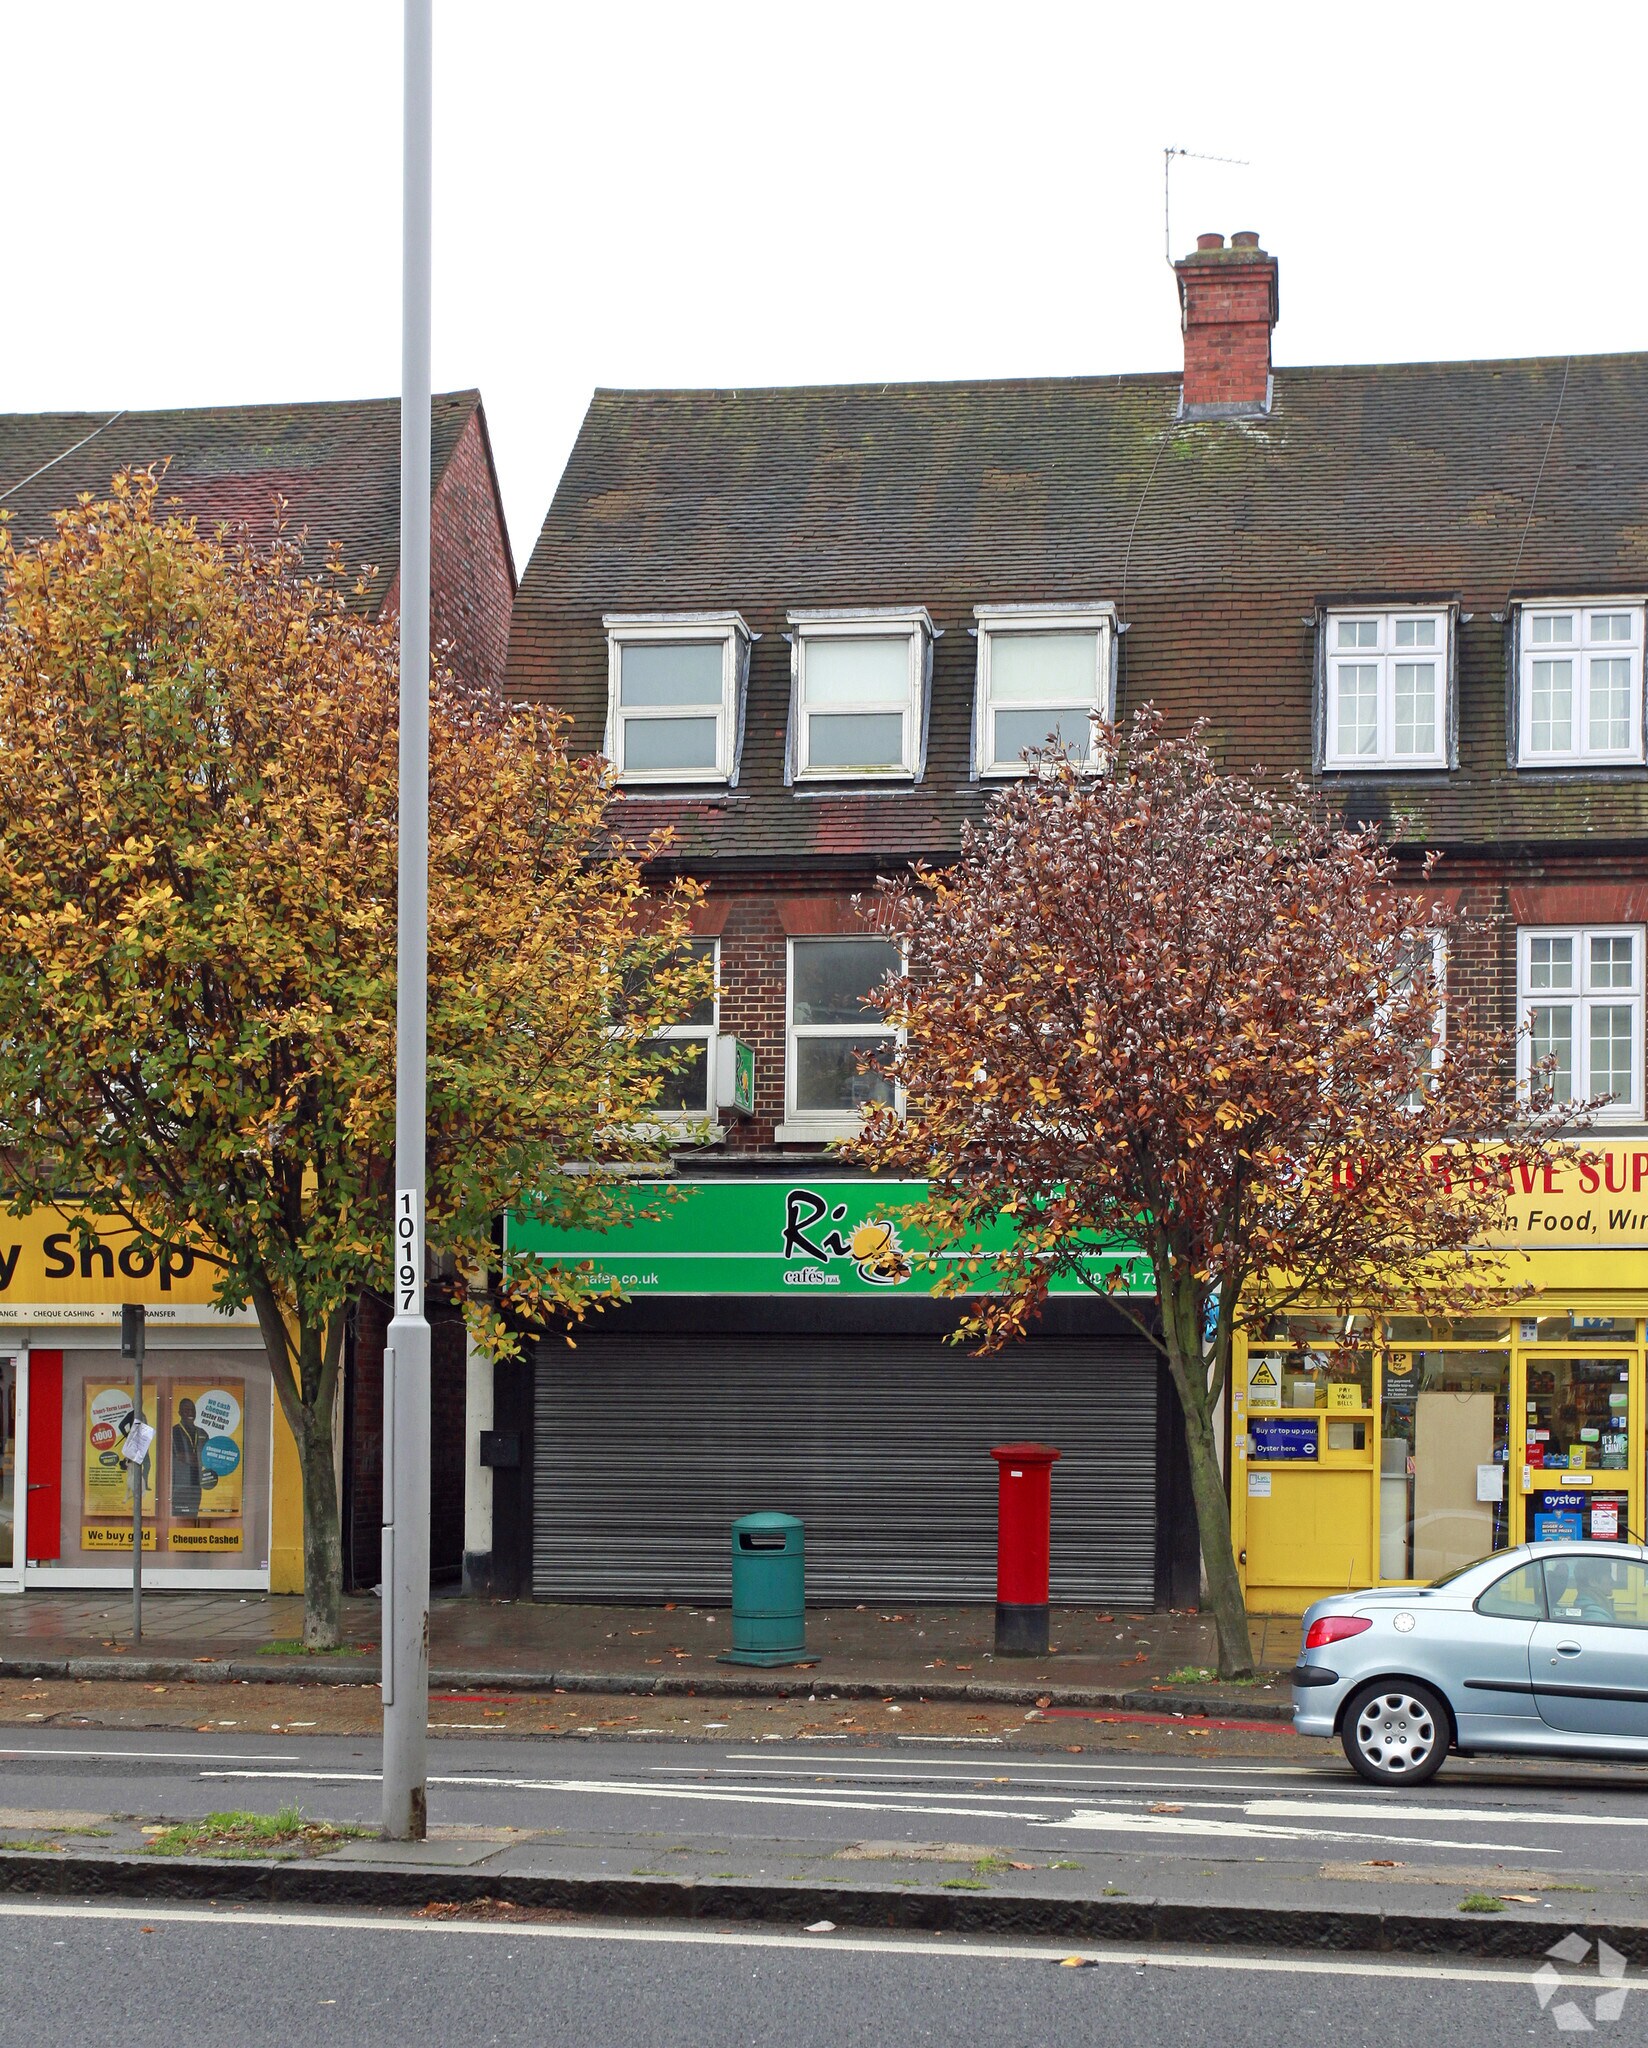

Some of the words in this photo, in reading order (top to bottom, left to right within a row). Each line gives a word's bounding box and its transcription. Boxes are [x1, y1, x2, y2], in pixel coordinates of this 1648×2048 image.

[1527, 1210, 1597, 1234] Food,
[399, 1193, 415, 1310] 10197
[43, 1233, 194, 1291] Shop
[784, 1267, 824, 1283] cafés
[33, 1310, 62, 1318] CHEQUE
[64, 1310, 95, 1318] CASHING
[144, 1310, 176, 1318] RANSFER
[205, 1405, 229, 1418] cheques
[217, 1401, 231, 1411] cash
[201, 1411, 217, 1421] faster
[201, 1418, 211, 1427] any
[212, 1421, 226, 1431] bank
[1545, 1494, 1581, 1507] oyster
[88, 1531, 103, 1540] We
[106, 1531, 125, 1543] buy
[128, 1531, 150, 1543] gld
[173, 1534, 208, 1545] Cheques
[209, 1535, 239, 1544] Cashed
